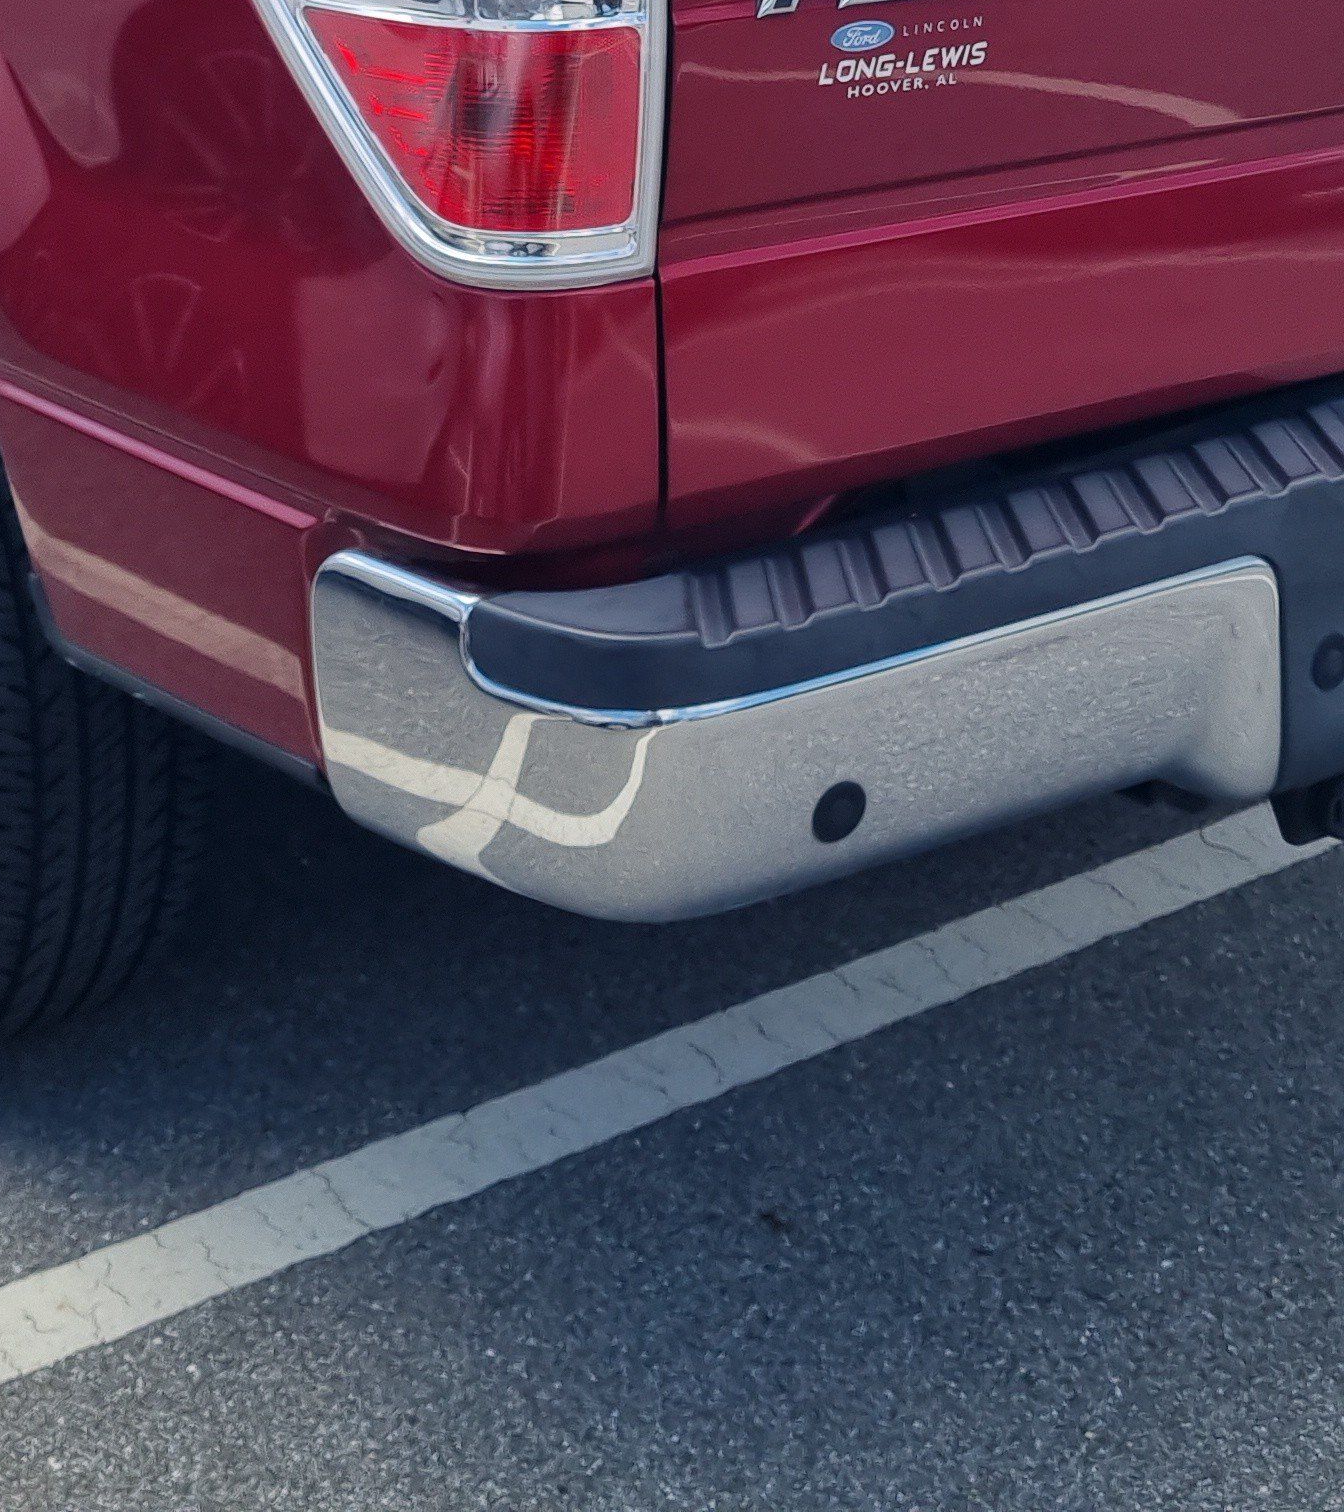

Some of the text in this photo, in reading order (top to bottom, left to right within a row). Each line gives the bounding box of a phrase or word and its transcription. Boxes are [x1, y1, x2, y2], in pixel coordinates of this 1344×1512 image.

[902, 16, 984, 37] LINCOLN
[818, 41, 988, 86] LONG-LEWIS
[935, 72, 958, 87] AL
